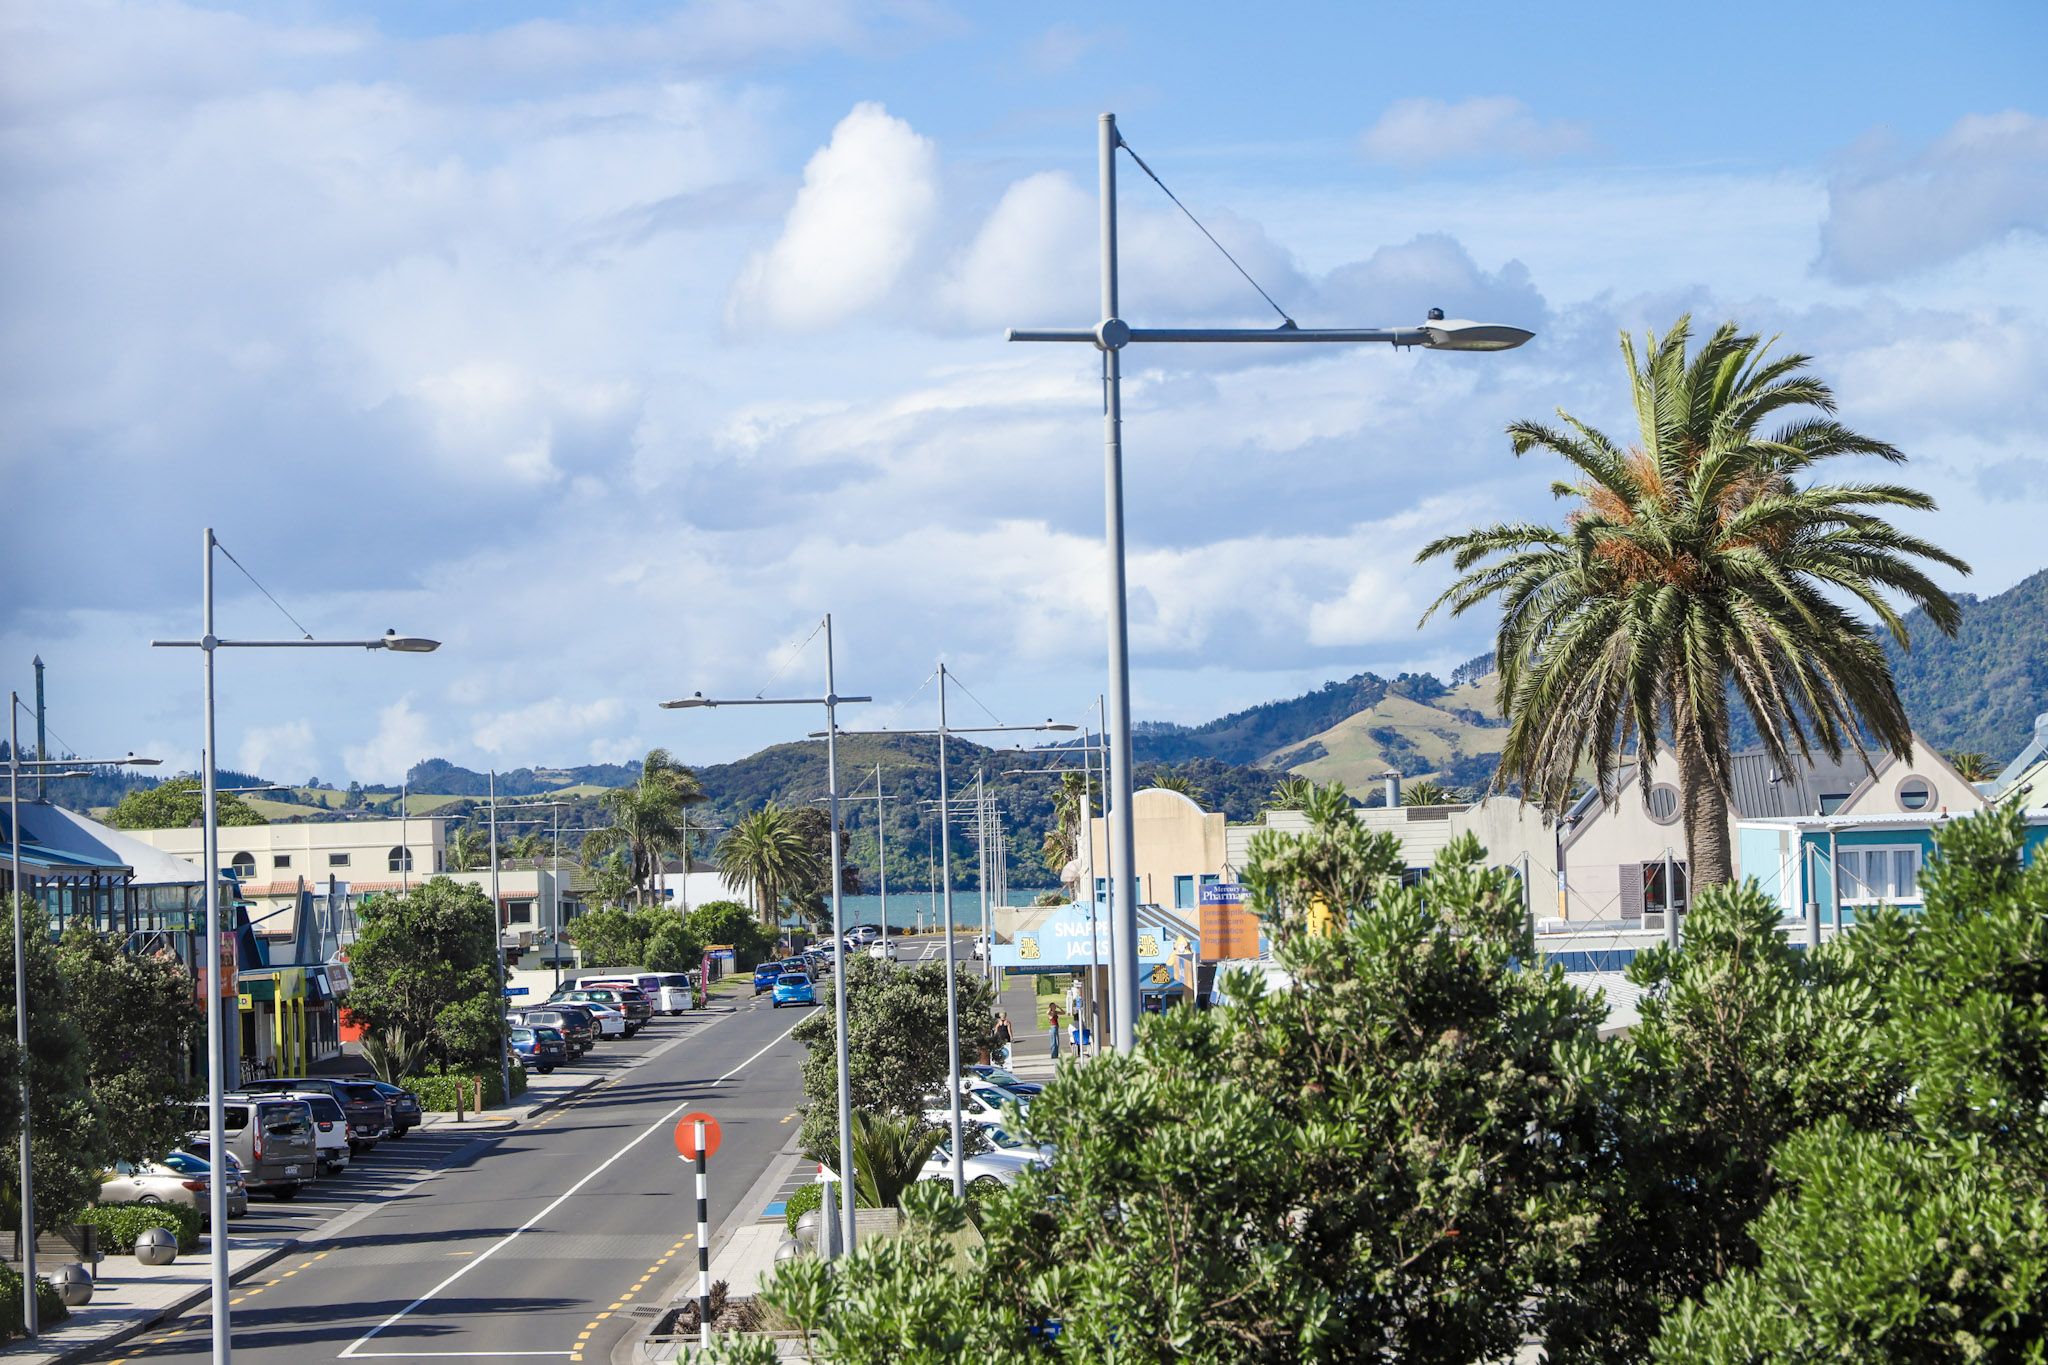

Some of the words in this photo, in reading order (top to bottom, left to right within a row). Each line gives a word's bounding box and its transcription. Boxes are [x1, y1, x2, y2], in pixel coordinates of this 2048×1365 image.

[1203, 890, 1251, 900] Pharmay
[1054, 921, 1115, 937] SNAPPE
[1019, 947, 1040, 959] CHIPS
[1137, 944, 1159, 956] CHIPS
